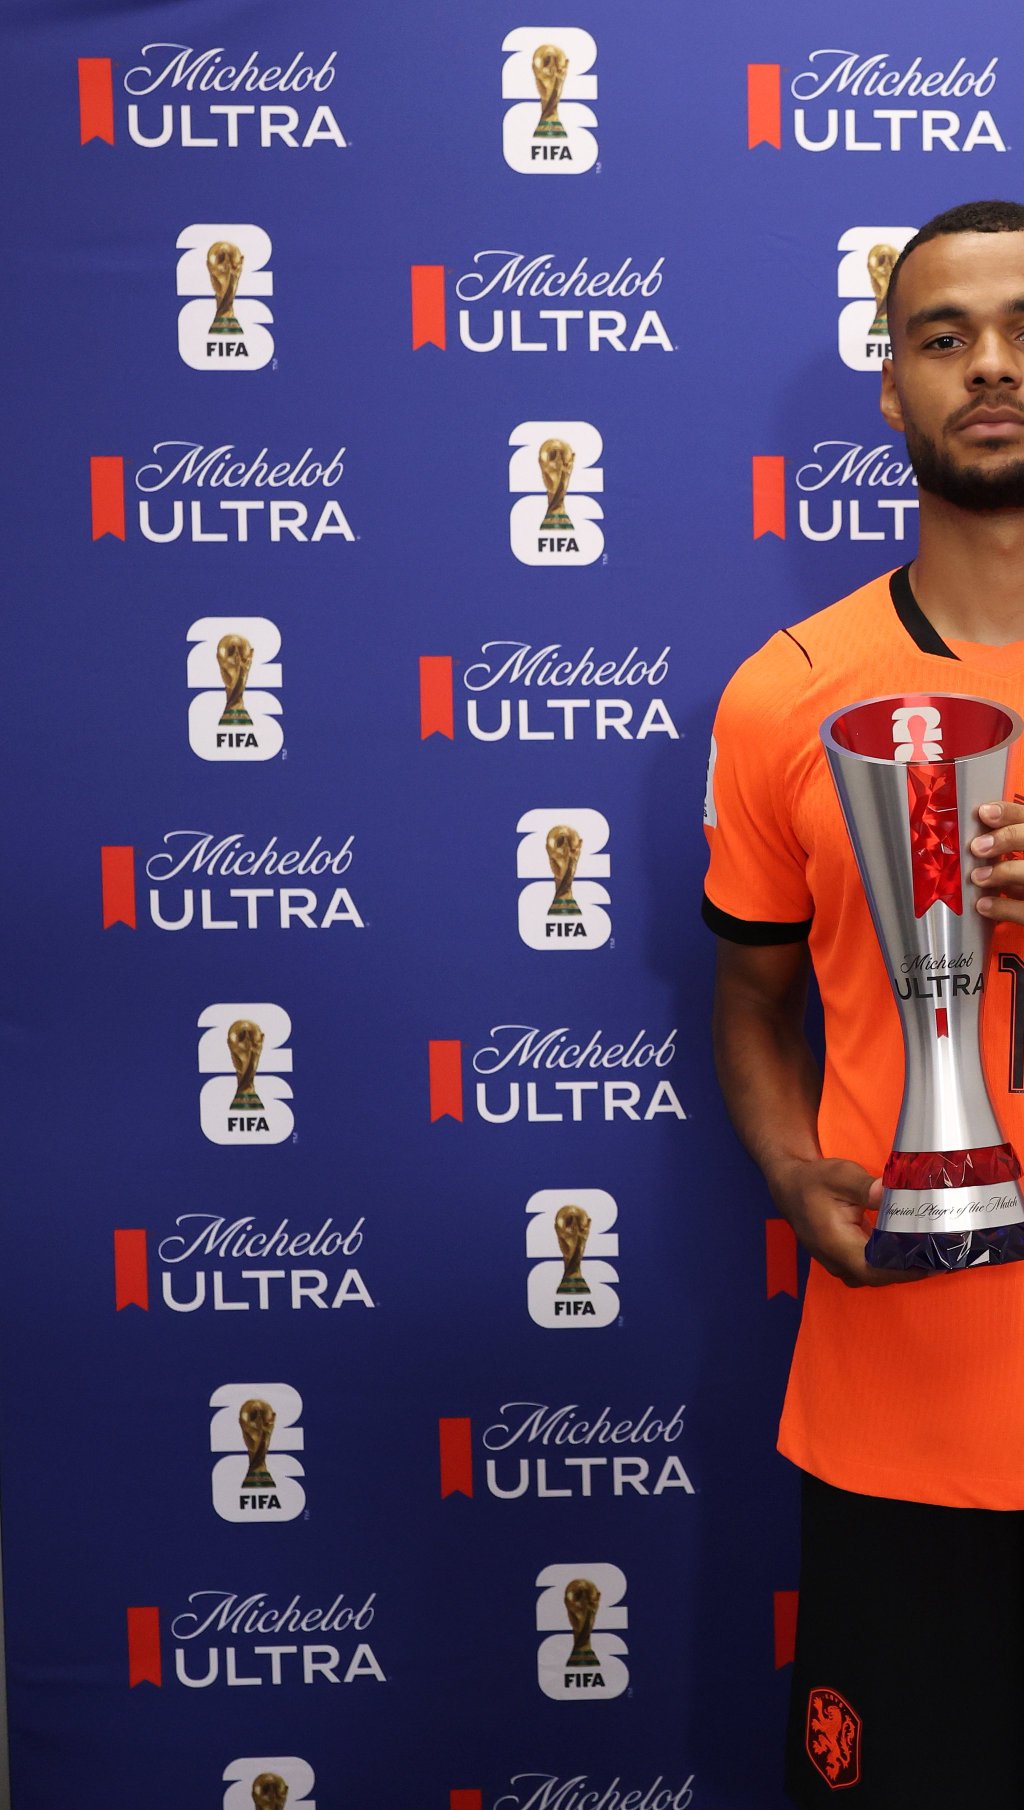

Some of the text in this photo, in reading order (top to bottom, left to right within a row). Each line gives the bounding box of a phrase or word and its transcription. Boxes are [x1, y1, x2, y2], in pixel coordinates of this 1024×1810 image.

[123, 42, 338, 96] Michelob
[790, 48, 999, 101] Michelob
[127, 103, 348, 149] ULTRA
[794, 108, 1007, 153] ULTRA
[531, 145, 573, 161] FIFA
[455, 249, 666, 302] Michelob
[206, 341, 249, 357] FIFA
[459, 309, 674, 353] ULTRA
[865, 343, 893, 358] FIF
[135, 440, 347, 493] Michelob
[138, 500, 356, 544] ULTRA
[798, 499, 920, 542] ULT
[537, 537, 580, 553] FIFA
[463, 640, 671, 692] Michelob
[216, 732, 259, 748] FIFA
[466, 698, 680, 742] ULTRA
[145, 830, 355, 881] Michelob
[149, 887, 365, 931] ULTRA
[545, 922, 588, 938] FIFA
[901, 952, 975, 974] Michelob
[894, 973, 985, 1001] ULTRA
[472, 1024, 678, 1075] Michelob
[227, 1116, 270, 1132] FIFA
[476, 1080, 687, 1124] ULTRA
[915, 1202, 955, 1220] Player
[969, 1201, 985, 1213] the
[986, 1195, 1018, 1213] Match
[157, 1213, 366, 1264] Michelob
[161, 1268, 376, 1313] ULTRA
[554, 1300, 596, 1316] FIFA
[482, 1401, 687, 1451] Michelob
[486, 1455, 696, 1500] ULTRA
[239, 1494, 282, 1510] FIFA
[170, 1590, 377, 1640] Michelob
[174, 1643, 387, 1689] ULTRA
[564, 1672, 606, 1689] FIFA
[493, 1772, 695, 1810] Michelob
